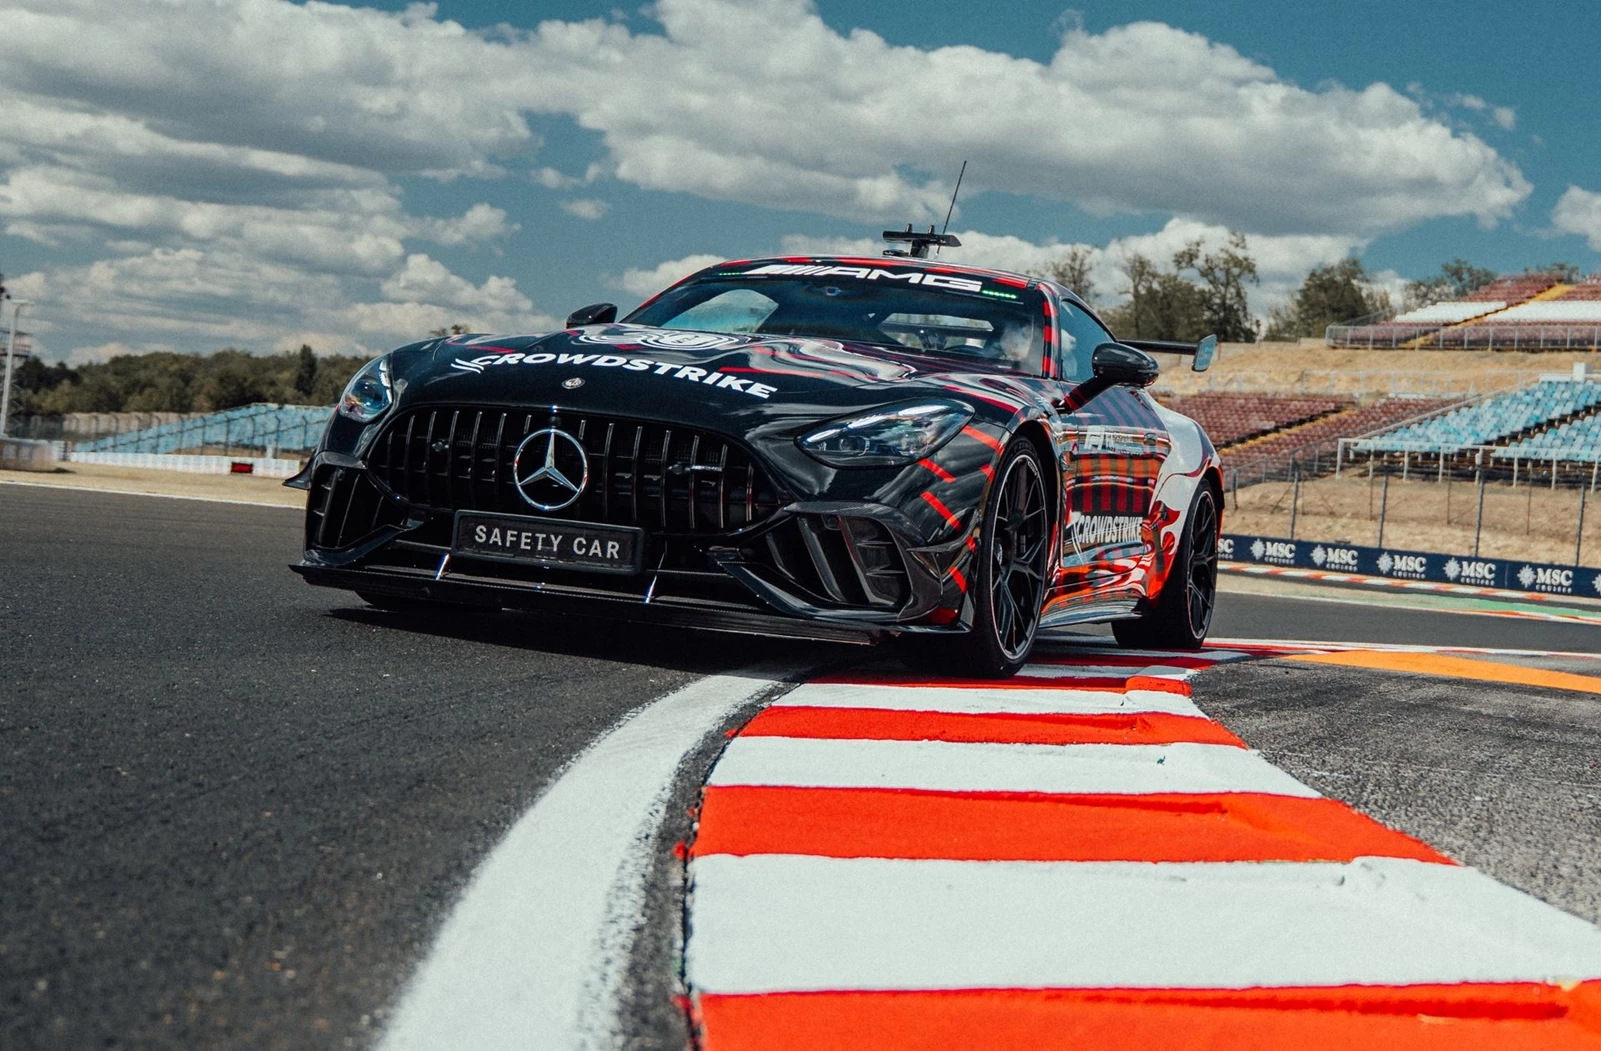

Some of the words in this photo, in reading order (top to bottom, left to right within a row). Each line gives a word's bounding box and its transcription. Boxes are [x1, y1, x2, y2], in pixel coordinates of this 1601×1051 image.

[822, 266, 983, 293] AMG
[469, 352, 778, 399] CROWDSTRIKE
[1075, 515, 1143, 544] CROWDSTRIKE
[474, 525, 563, 552] SAFETY
[573, 537, 620, 559] CAR
[1217, 538, 1235, 553] SC
[1264, 541, 1296, 559] MSC
[1326, 548, 1359, 565] MSC
[1393, 555, 1427, 573] MSC
[1461, 561, 1496, 580] MSC
[1536, 568, 1573, 587] MSC
